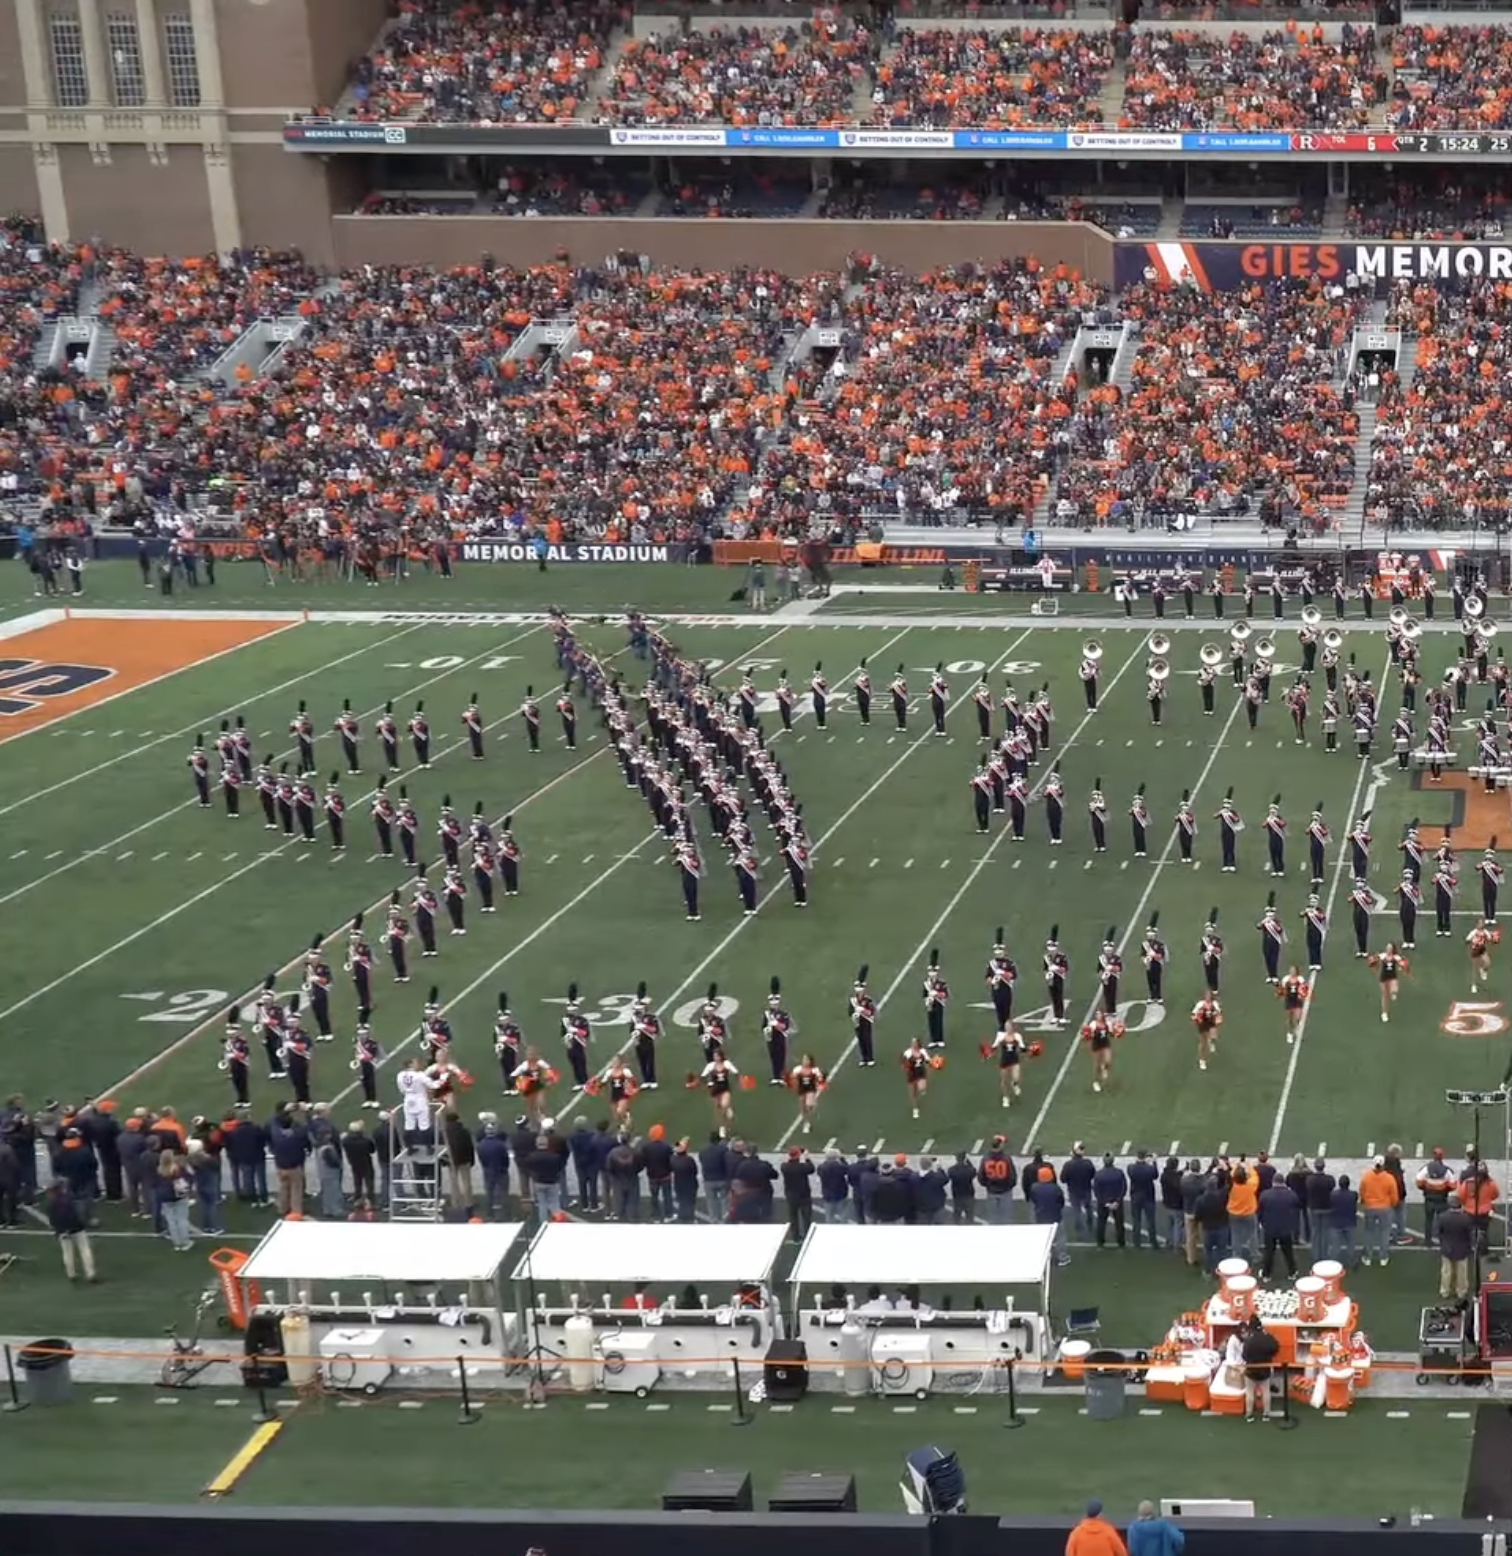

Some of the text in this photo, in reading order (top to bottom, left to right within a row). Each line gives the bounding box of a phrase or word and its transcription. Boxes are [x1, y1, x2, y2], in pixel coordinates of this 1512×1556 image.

[1300, 136, 1314, 149] R
[1368, 137, 1376, 150] 6
[1420, 138, 1428, 150] 2
[1440, 138, 1508, 150] 15:24 25
[1241, 245, 1340, 277] GIES
[464, 544, 668, 561] MEMORAL STADIUM
[582, 994, 739, 1028] 30
[984, 1160, 1008, 1179] 50
[1232, 1295, 1244, 1307] G
[1304, 1296, 1315, 1308] G
